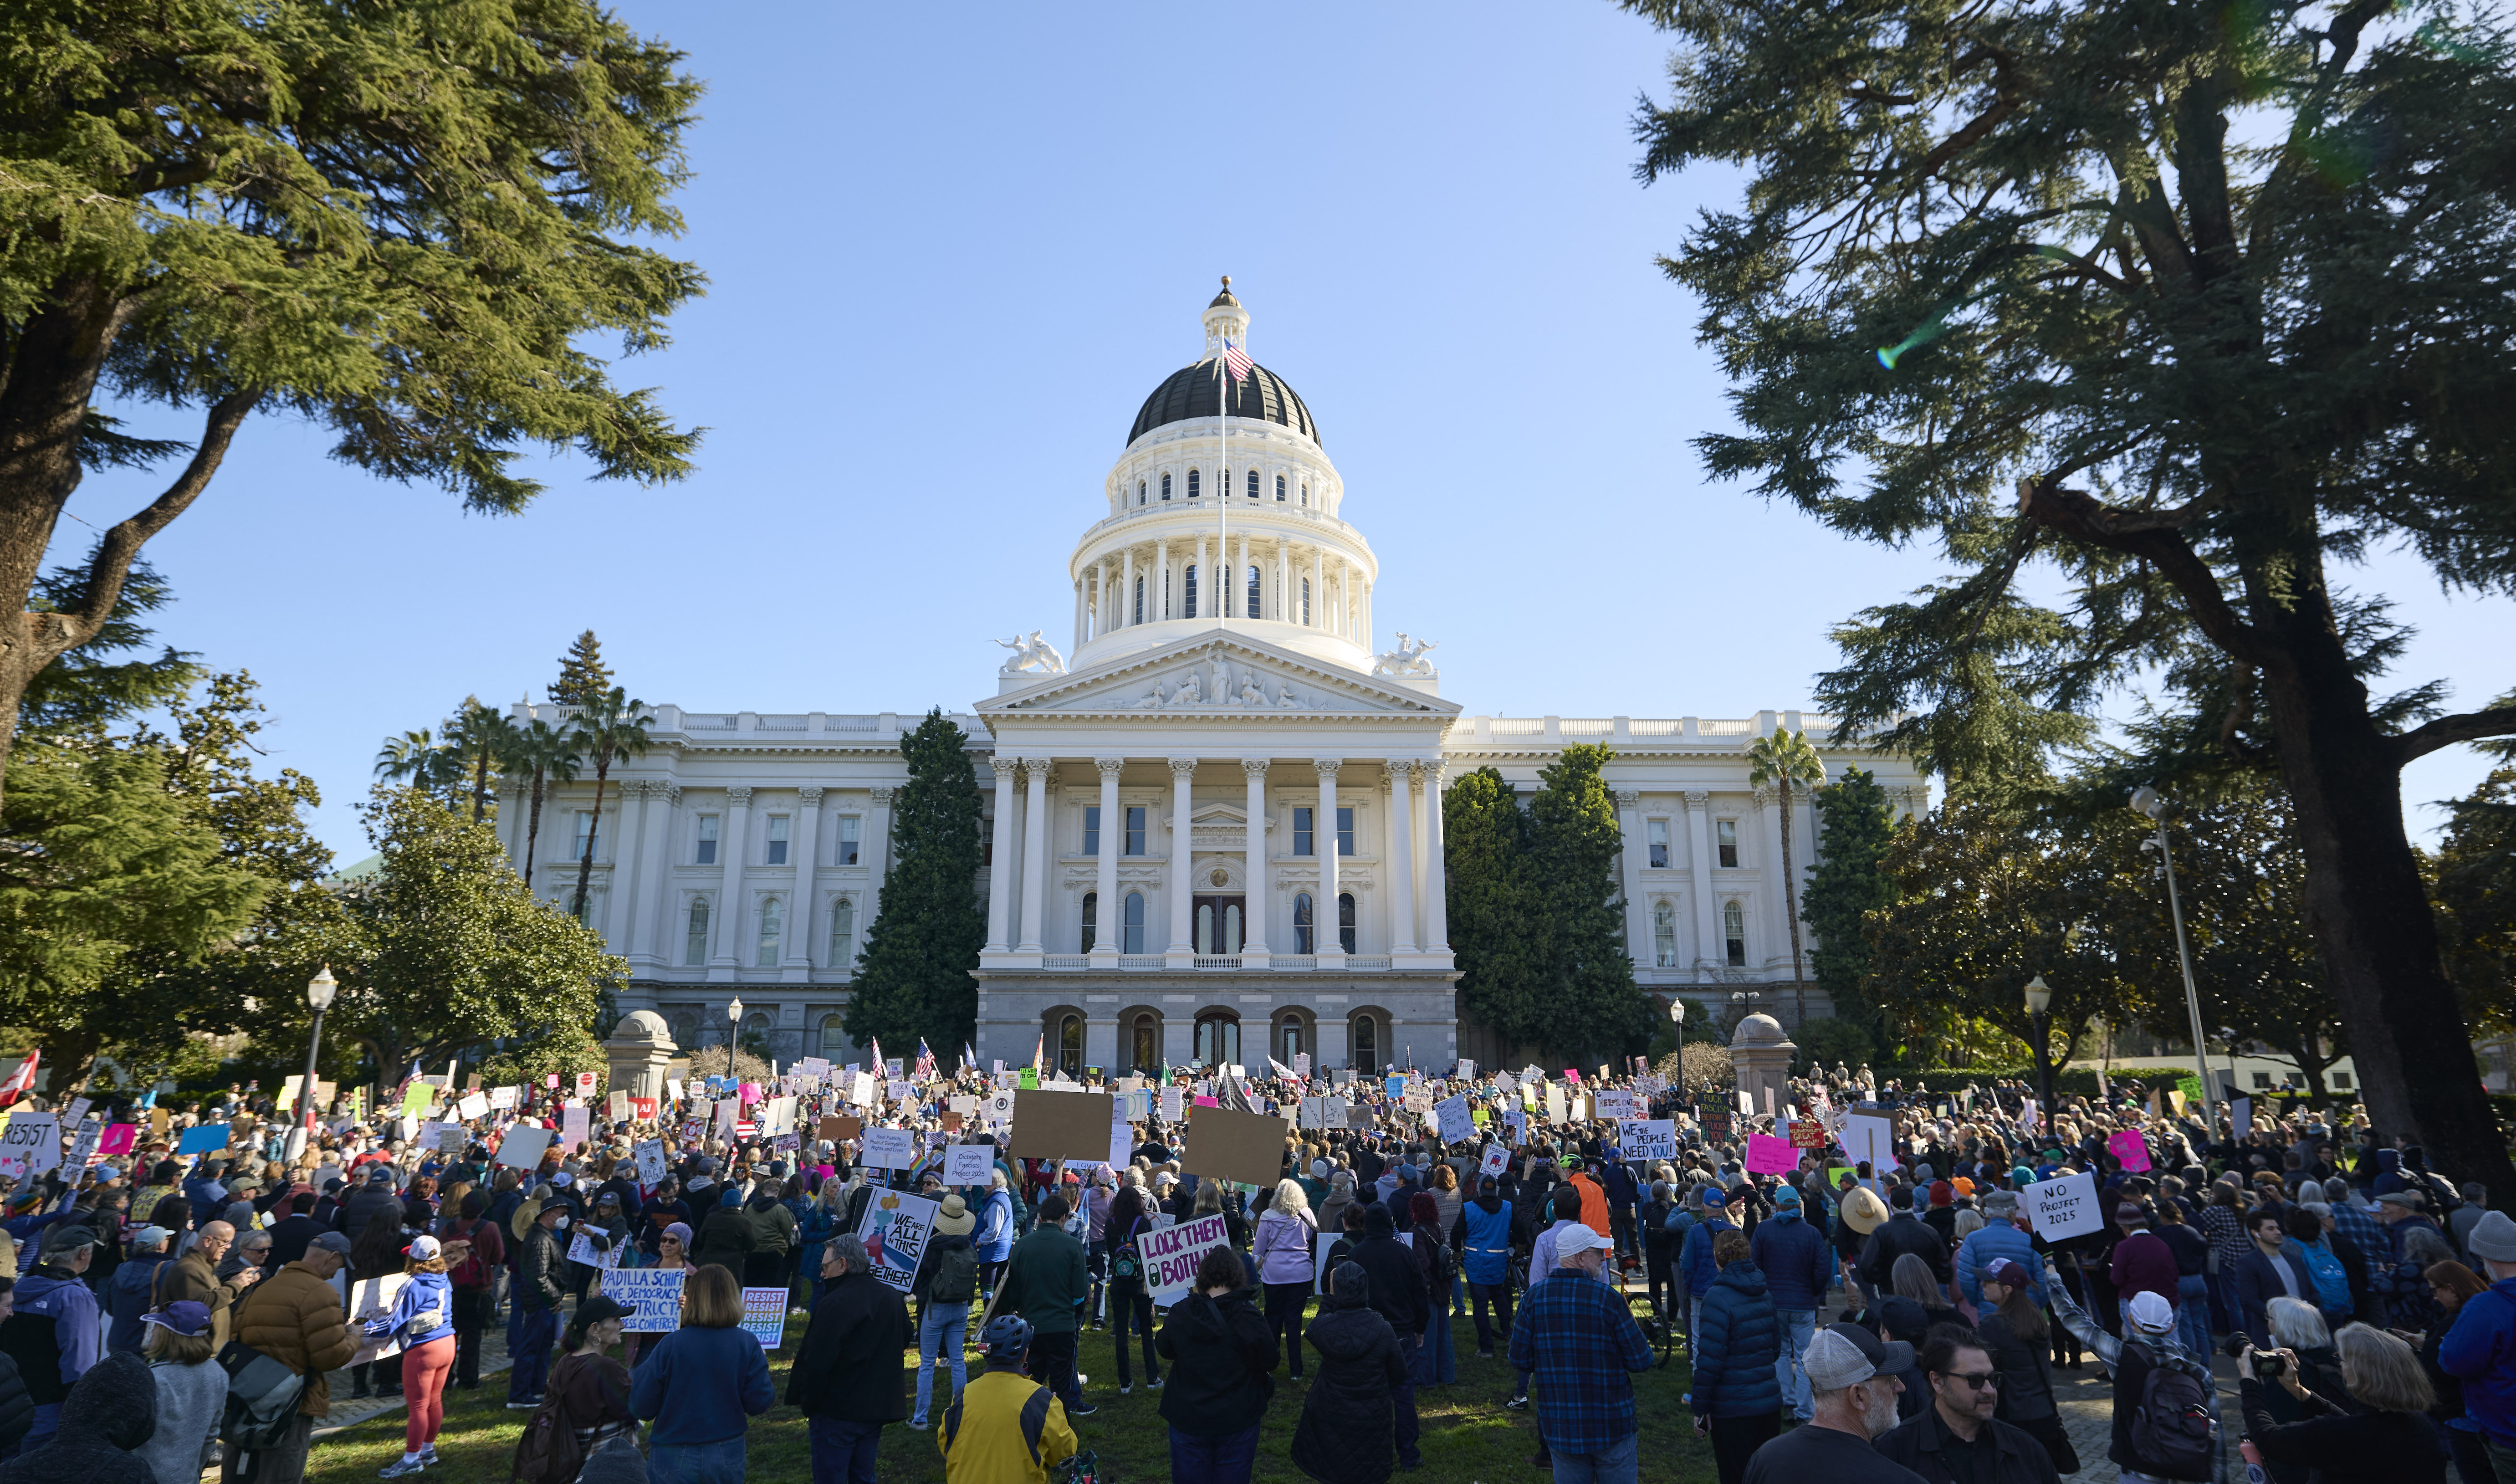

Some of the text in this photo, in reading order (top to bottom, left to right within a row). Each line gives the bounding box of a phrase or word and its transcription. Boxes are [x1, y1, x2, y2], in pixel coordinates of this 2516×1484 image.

[807, 1058, 828, 1067] FOCUS
[1704, 1094, 1723, 1104] FUCK
[1408, 1103, 1429, 1113] FEAR!
[1437, 1102, 1448, 1110] Your
[1701, 1103, 1730, 1114] FASCISM
[80, 1121, 101, 1132] EQUITY
[1621, 1123, 1638, 1137] WE
[1706, 1121, 1727, 1131] FUCKS
[1, 1124, 52, 1147] RESIST
[77, 1135, 96, 1145] IS NOT
[1636, 1133, 1668, 1145] PEOPLE
[1709, 1131, 1724, 1140] YOU
[776, 1141, 799, 1152] THUGS
[884, 1140, 906, 1148] Everyone's
[1488, 1144, 1507, 1156] Resist
[1623, 1143, 1672, 1158] NEED YOU!
[64, 1166, 82, 1177] GAME
[639, 1166, 666, 1182] MAGA
[2044, 1184, 2067, 1199] NO
[2040, 1197, 2081, 1213] PROJECT
[894, 1212, 926, 1231] WE ARE
[2048, 1210, 2076, 1225] 2025
[889, 1225, 920, 1242] ALL
[1144, 1217, 1226, 1259] LOCK THEM
[895, 1238, 919, 1258] THIS
[1160, 1251, 1201, 1286] BOTH
[651, 1271, 685, 1288] SCHIFF
[869, 1264, 911, 1286] GETHER
[602, 1287, 682, 1301] SAVE DEMOCRACY
[746, 1292, 784, 1302] RESIST
[745, 1302, 782, 1312] RESIST
[743, 1313, 781, 1322] RESIST
[742, 1323, 779, 1332] RESIST
[754, 1333, 778, 1342] SIST
